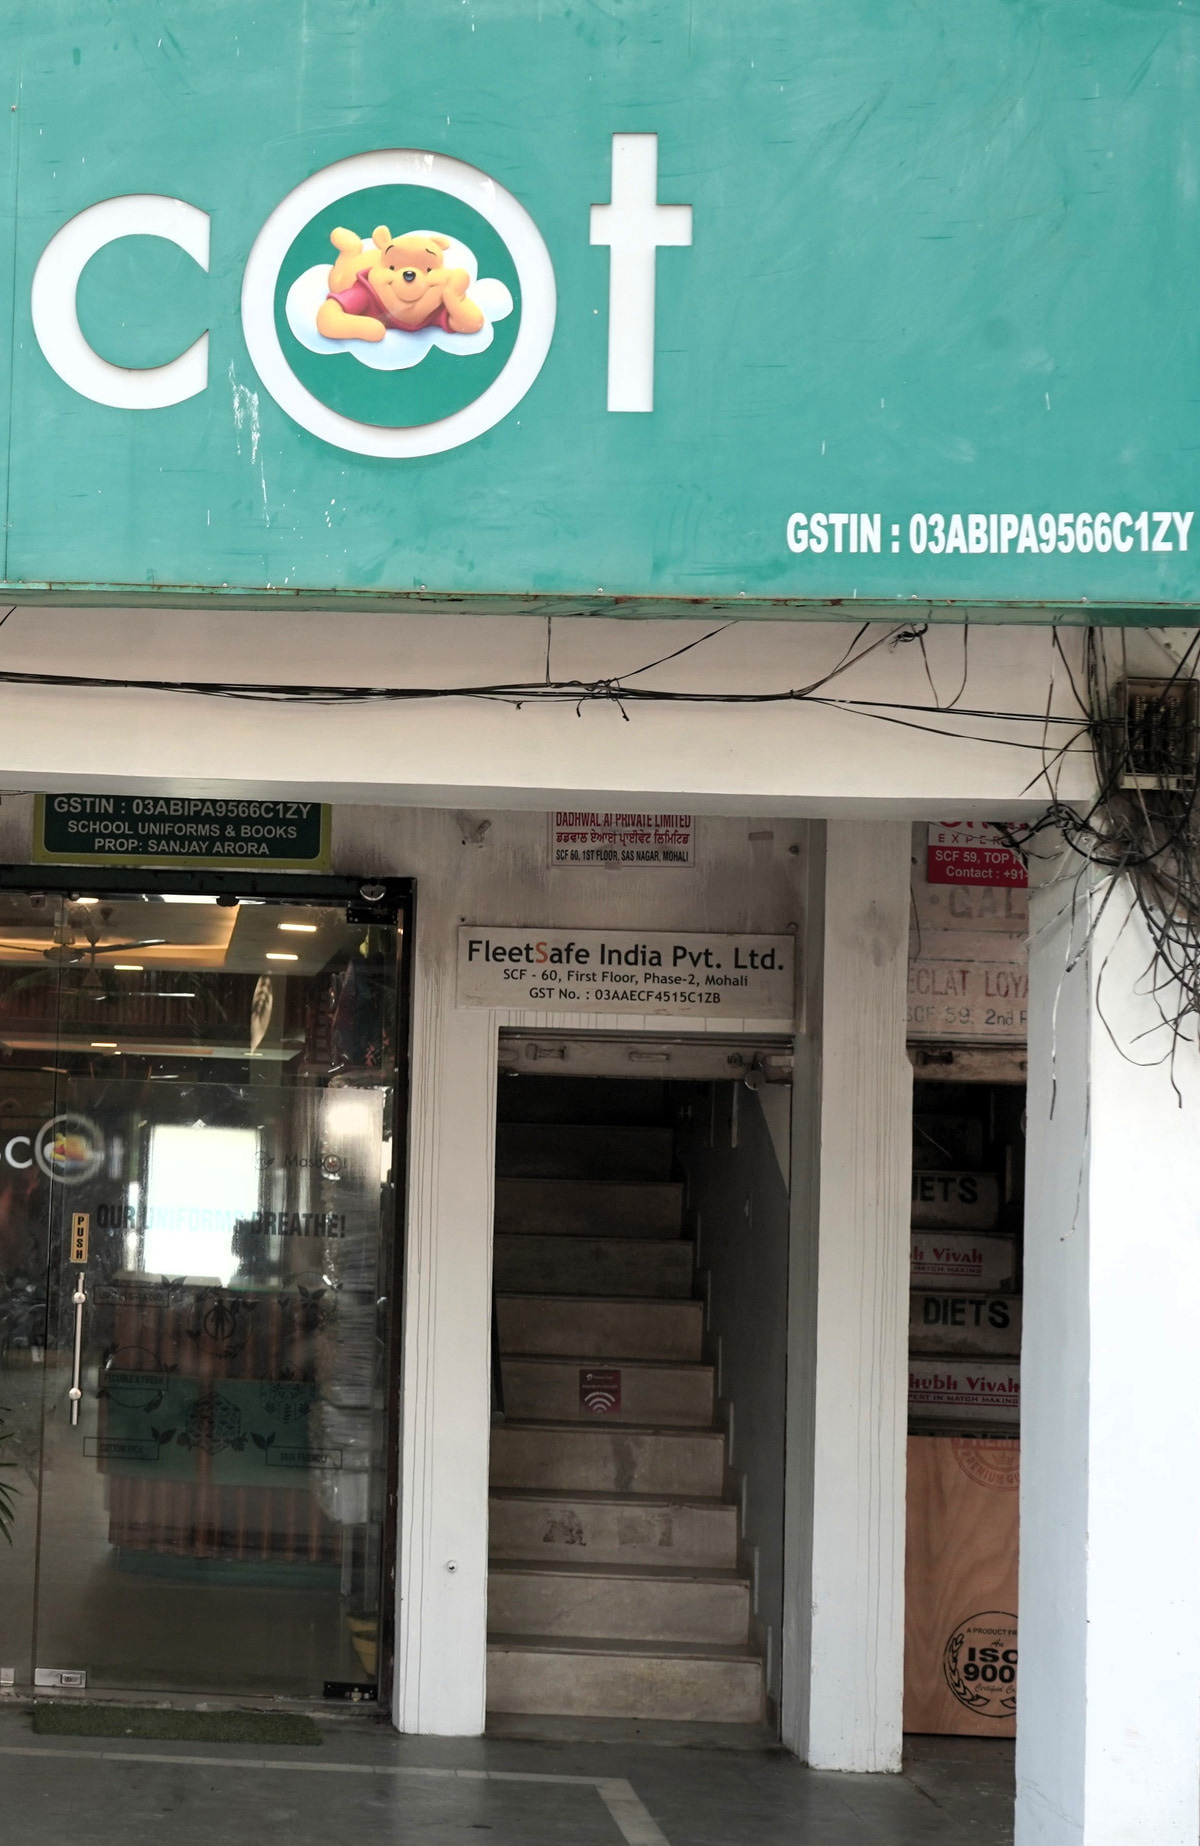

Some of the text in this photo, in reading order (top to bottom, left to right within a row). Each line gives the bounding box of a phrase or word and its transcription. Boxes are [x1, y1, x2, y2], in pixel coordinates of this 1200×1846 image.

[786, 512, 881, 553] GSTIN
[908, 511, 1195, 554] 03ABIPA9566C1ZY
[53, 797, 114, 815] GSTIN
[132, 798, 312, 820] 03ABIPA9566C1ZY
[556, 811, 601, 827] DADHWAL
[67, 820, 298, 839] SCHOOL UNIFORMS & BOOKS
[94, 838, 270, 855] PROP: SANJAY ARORA
[556, 849, 569, 861] SCF
[621, 850, 634, 862] SAS
[662, 851, 689, 862] MOHALI
[935, 850, 960, 862] SCF
[963, 851, 980, 864] 59,
[984, 852, 1009, 864] TOP
[946, 865, 992, 879] Contact
[467, 939, 784, 970] FleetSafe India Pvt. Ltd.
[503, 968, 527, 980] SCF
[541, 970, 561, 983] 60,
[567, 970, 597, 983] First
[601, 971, 639, 986] Floor,
[644, 972, 700, 987] Phase-2,
[705, 974, 748, 987] Mohali
[529, 987, 555, 1000] GST
[559, 988, 580, 1000] No.
[985, 1008, 1014, 1026] 2nd
[96, 1203, 136, 1229] OUR
[252, 1210, 347, 1239] BREATHE!
[76, 1216, 85, 1259] PUSH
[923, 1296, 1010, 1329] DIETS
[966, 1376, 1020, 1393] Vivah
[968, 1647, 1018, 1665] ISO
